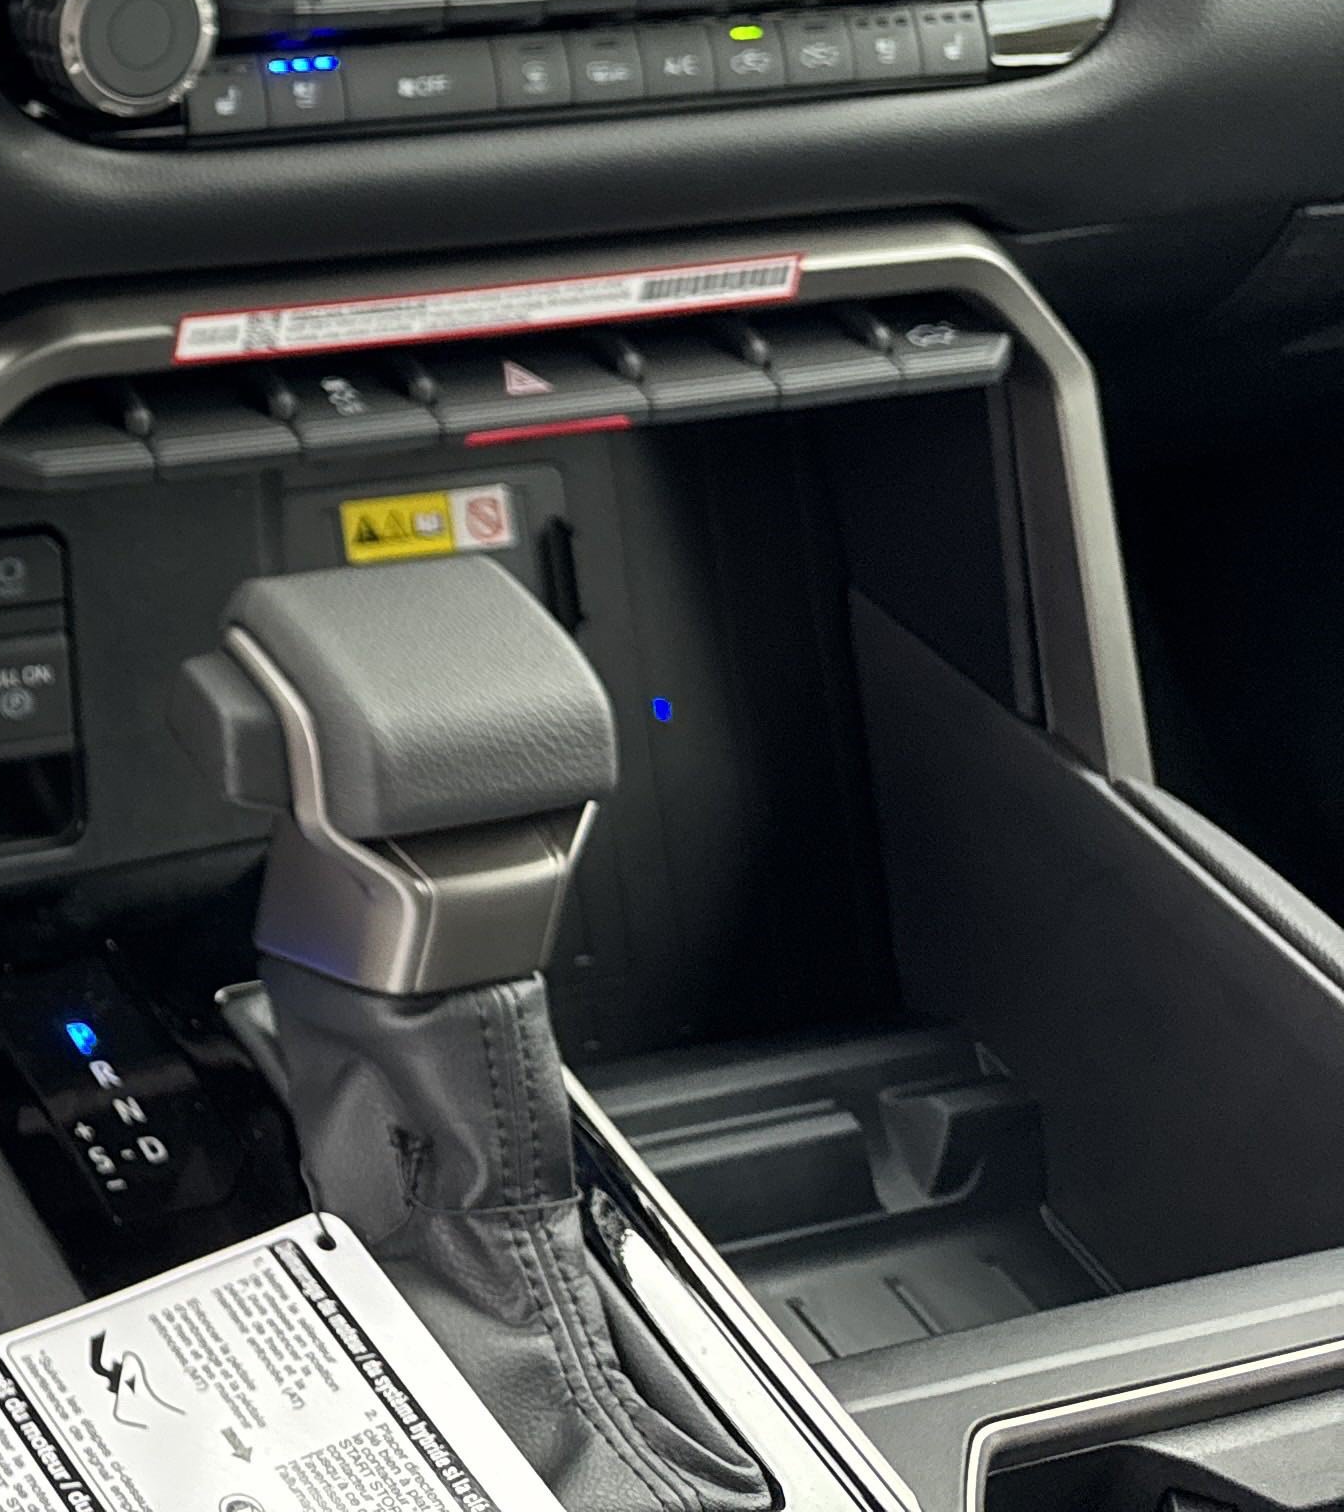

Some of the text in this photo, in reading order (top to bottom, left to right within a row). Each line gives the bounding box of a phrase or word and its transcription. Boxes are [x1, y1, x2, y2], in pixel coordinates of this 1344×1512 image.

[88, 1059, 123, 1089] R
[112, 1095, 149, 1127] N
[87, 1145, 117, 1175] S
[136, 1135, 170, 1165] D
[0, 1394, 35, 1422] du
[368, 1373, 423, 1426] système
[404, 1420, 456, 1469] hybride
[17, 1418, 76, 1484] moteur
[335, 1437, 376, 1481] START
[374, 1421, 411, 1461] Placer
[323, 1442, 376, 1504] contacteur
[359, 1445, 412, 1507] contacteur
[376, 1448, 404, 1476] bien
[404, 1487, 432, 1512] plat
[65, 1487, 100, 1512] du
